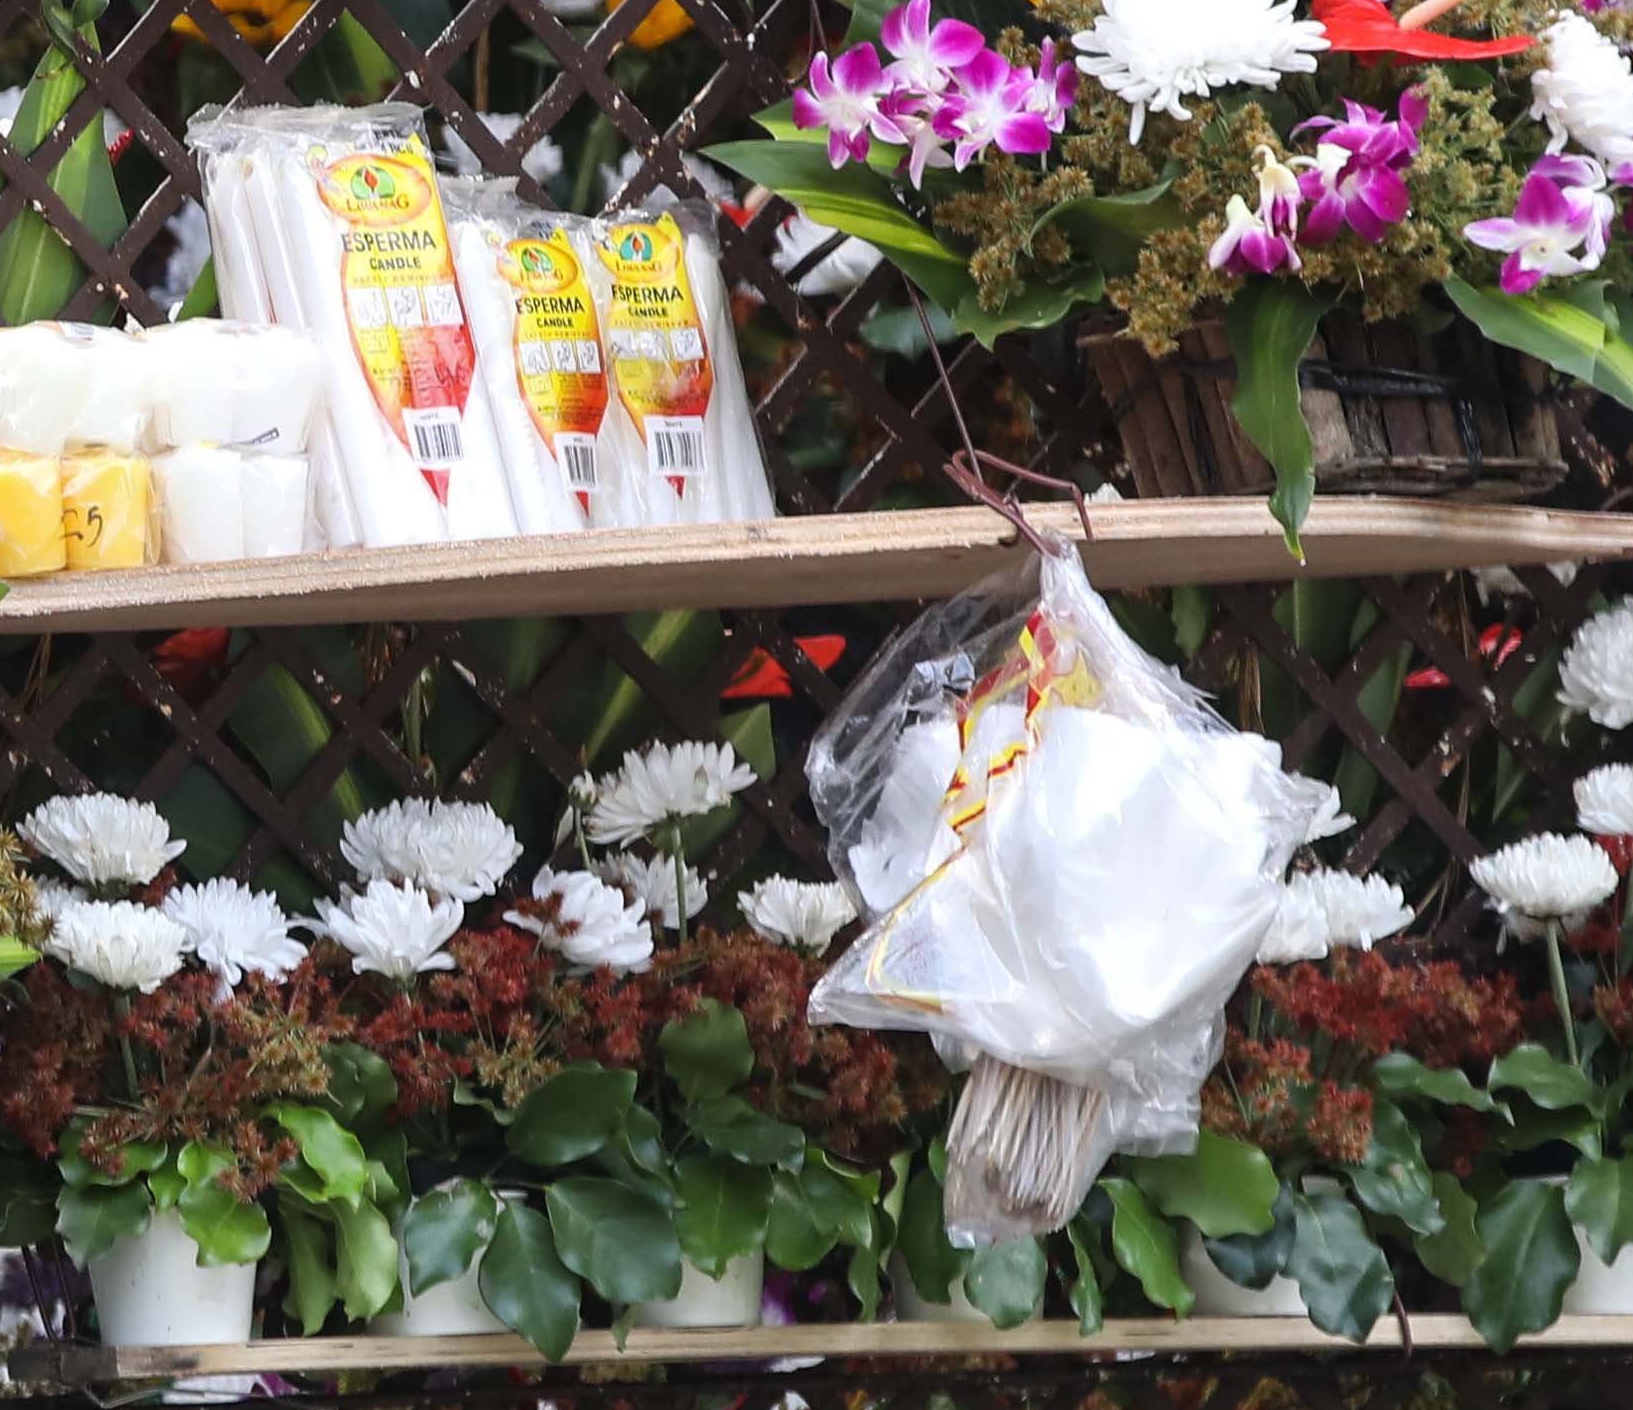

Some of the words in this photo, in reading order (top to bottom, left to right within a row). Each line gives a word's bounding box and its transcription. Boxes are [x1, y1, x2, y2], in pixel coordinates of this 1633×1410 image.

[340, 230, 437, 252] ESPERMA
[369, 256, 422, 271] CANDLE
[611, 284, 685, 304] ESPERMA
[515, 296, 586, 314] ESPERMA
[628, 306, 669, 318] CANDLE
[536, 317, 574, 328] CANDLE
